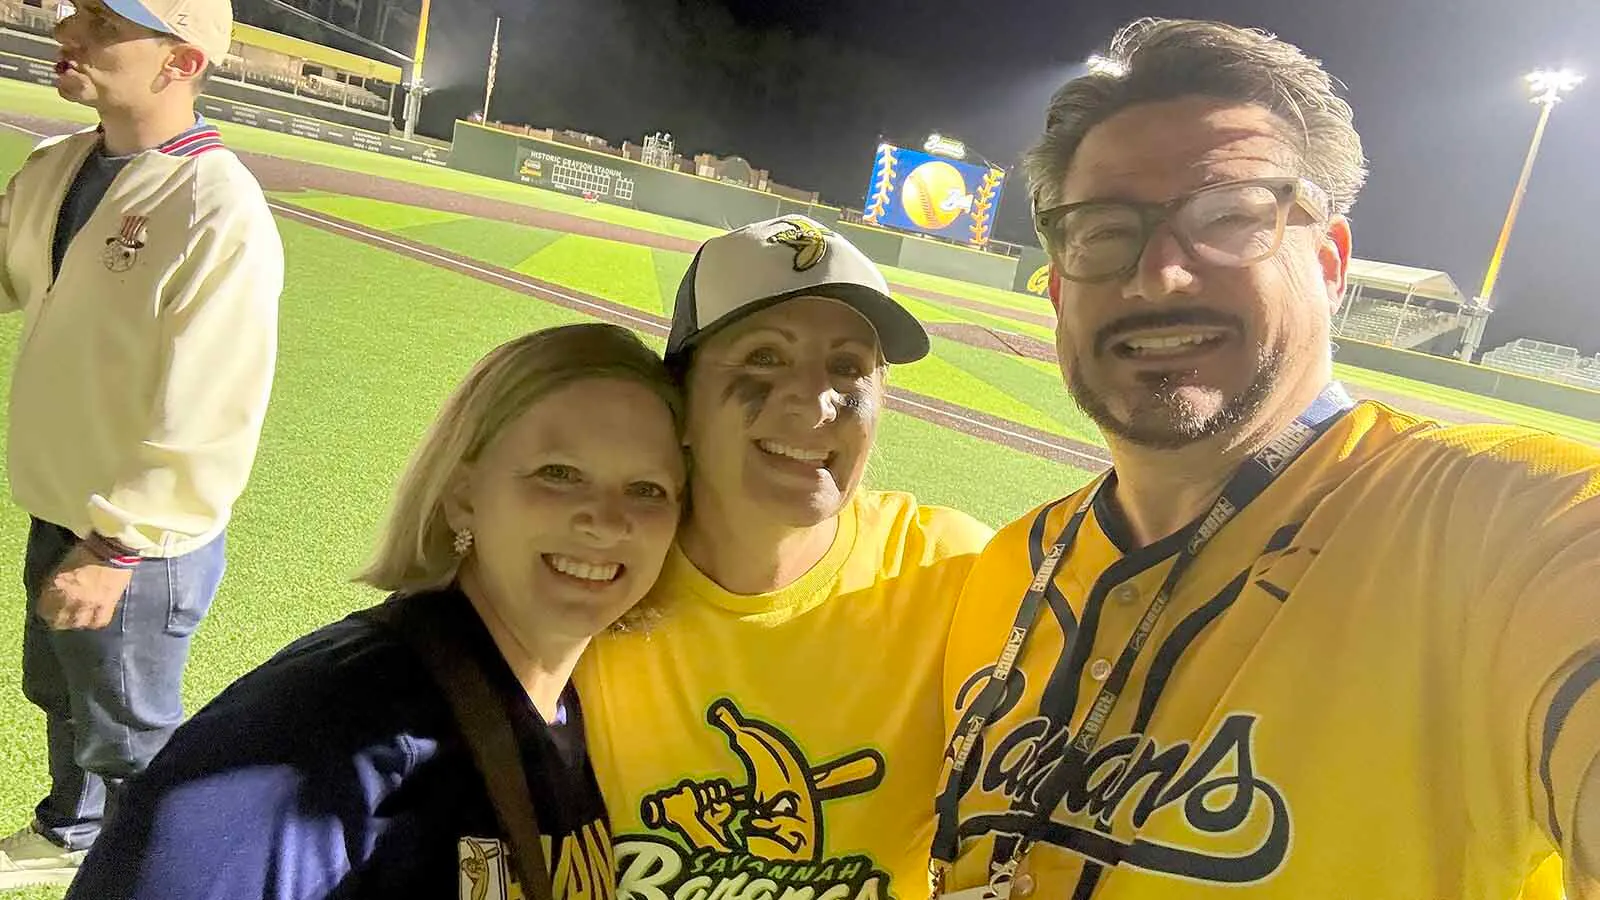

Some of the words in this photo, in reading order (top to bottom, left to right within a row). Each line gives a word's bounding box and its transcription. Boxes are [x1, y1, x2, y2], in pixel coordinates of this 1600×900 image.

[530, 151, 561, 163] HISTORIC
[562, 158, 593, 171] GRAYSON
[593, 164, 622, 177] STADIUM
[690, 852, 863, 881] SAVANNAH
